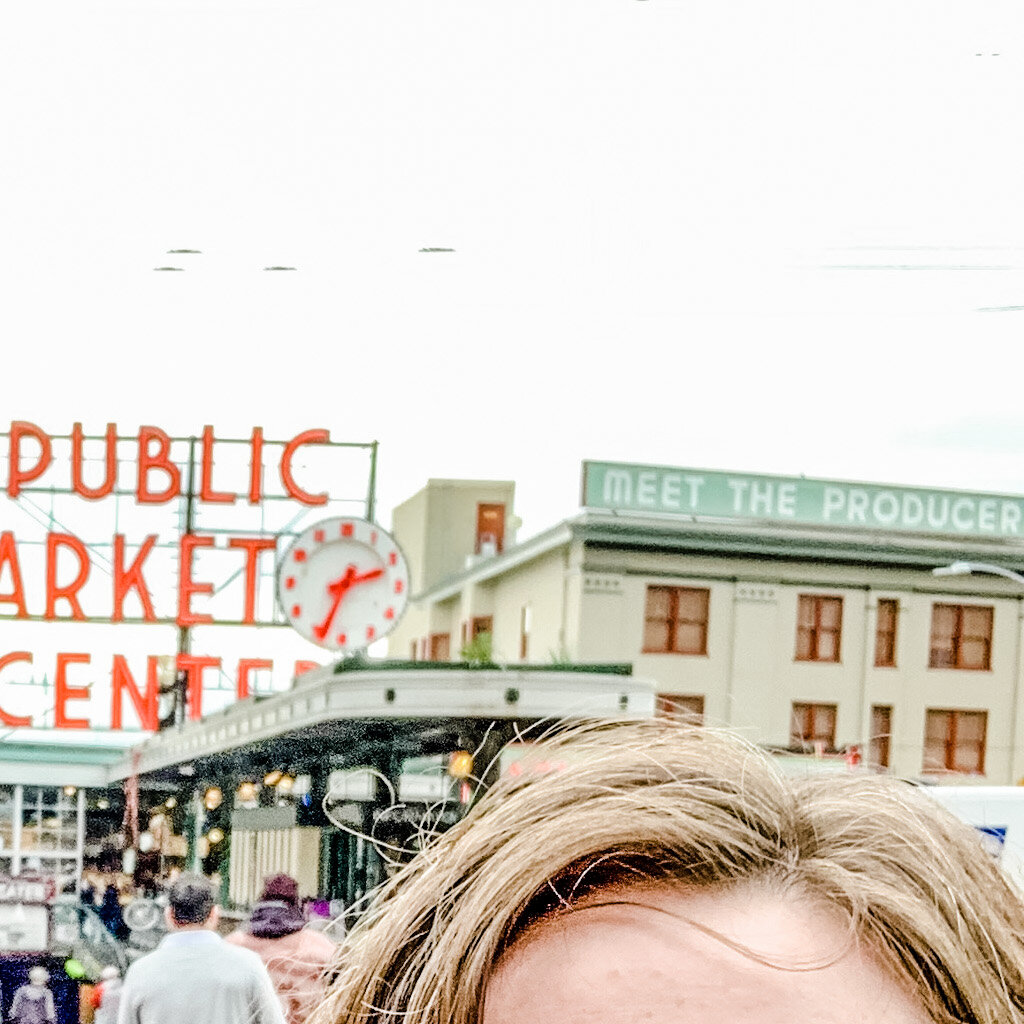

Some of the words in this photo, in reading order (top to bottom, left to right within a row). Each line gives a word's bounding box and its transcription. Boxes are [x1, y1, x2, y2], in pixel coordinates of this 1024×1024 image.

[5, 420, 331, 507] PUBLIC
[602, 468, 705, 509] MEET
[727, 477, 797, 518] THE
[822, 485, 1022, 535] PRODUCER
